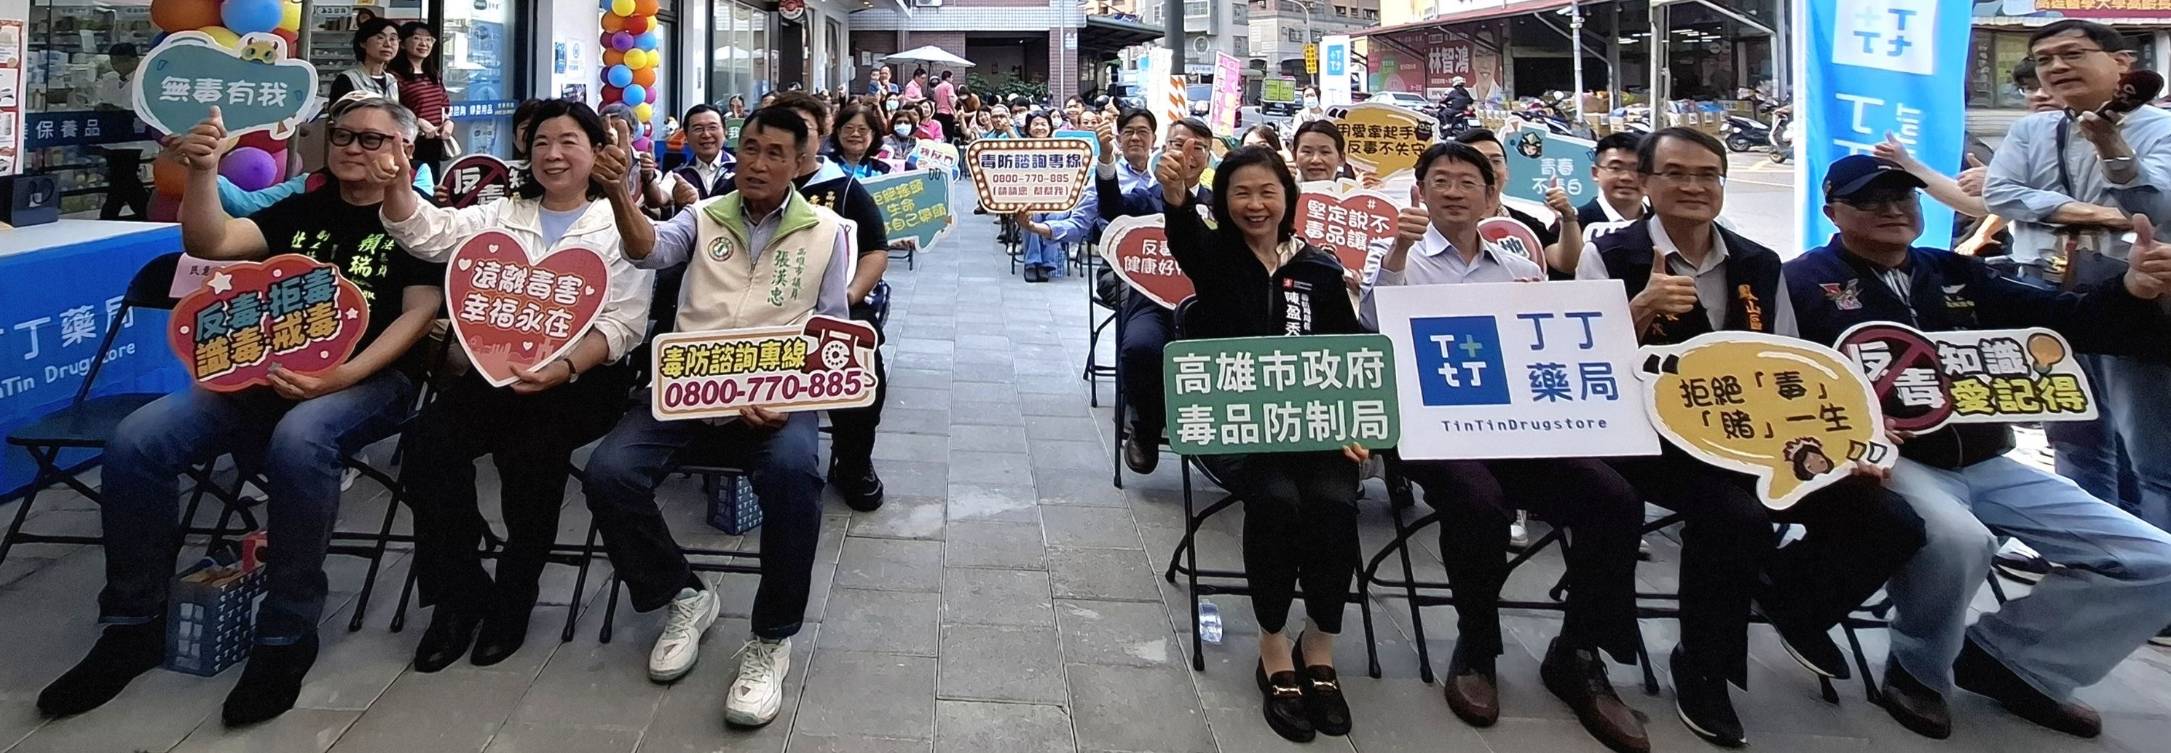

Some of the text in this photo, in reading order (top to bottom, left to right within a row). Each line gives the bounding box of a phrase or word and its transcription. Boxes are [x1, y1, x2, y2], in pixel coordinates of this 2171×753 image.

[160, 76, 288, 107] 無毒有我
[1336, 123, 1414, 140] 用愛牽起手
[1347, 140, 1426, 156] 反毒不失守
[981, 153, 1081, 169] 毒防諮詢專線
[992, 174, 1070, 183] 0800-770-885
[1541, 158, 1574, 176] 青春
[1531, 178, 1583, 196] 不白
[1304, 220, 1385, 251] 毒品讓
[1306, 200, 1391, 234] 堅定說不
[471, 261, 583, 305] 遠離毒害
[767, 249, 790, 307] 張漢忠
[1124, 256, 1182, 276] 健康好
[460, 293, 573, 338] 幸福永在
[1516, 311, 1603, 351] 丁丁
[44, 342, 136, 384] Drugore
[662, 339, 807, 378] 毒防諮詢專線
[1173, 347, 1385, 395] 高雄市政府
[1937, 338, 2028, 375] 知識
[665, 371, 862, 408] 0800-770-885
[1526, 361, 1620, 403] 藥局
[1950, 376, 2087, 413] 愛記得
[1176, 399, 1389, 446] 毒品防制局
[1441, 417, 1608, 432] TinTinDrugstore
